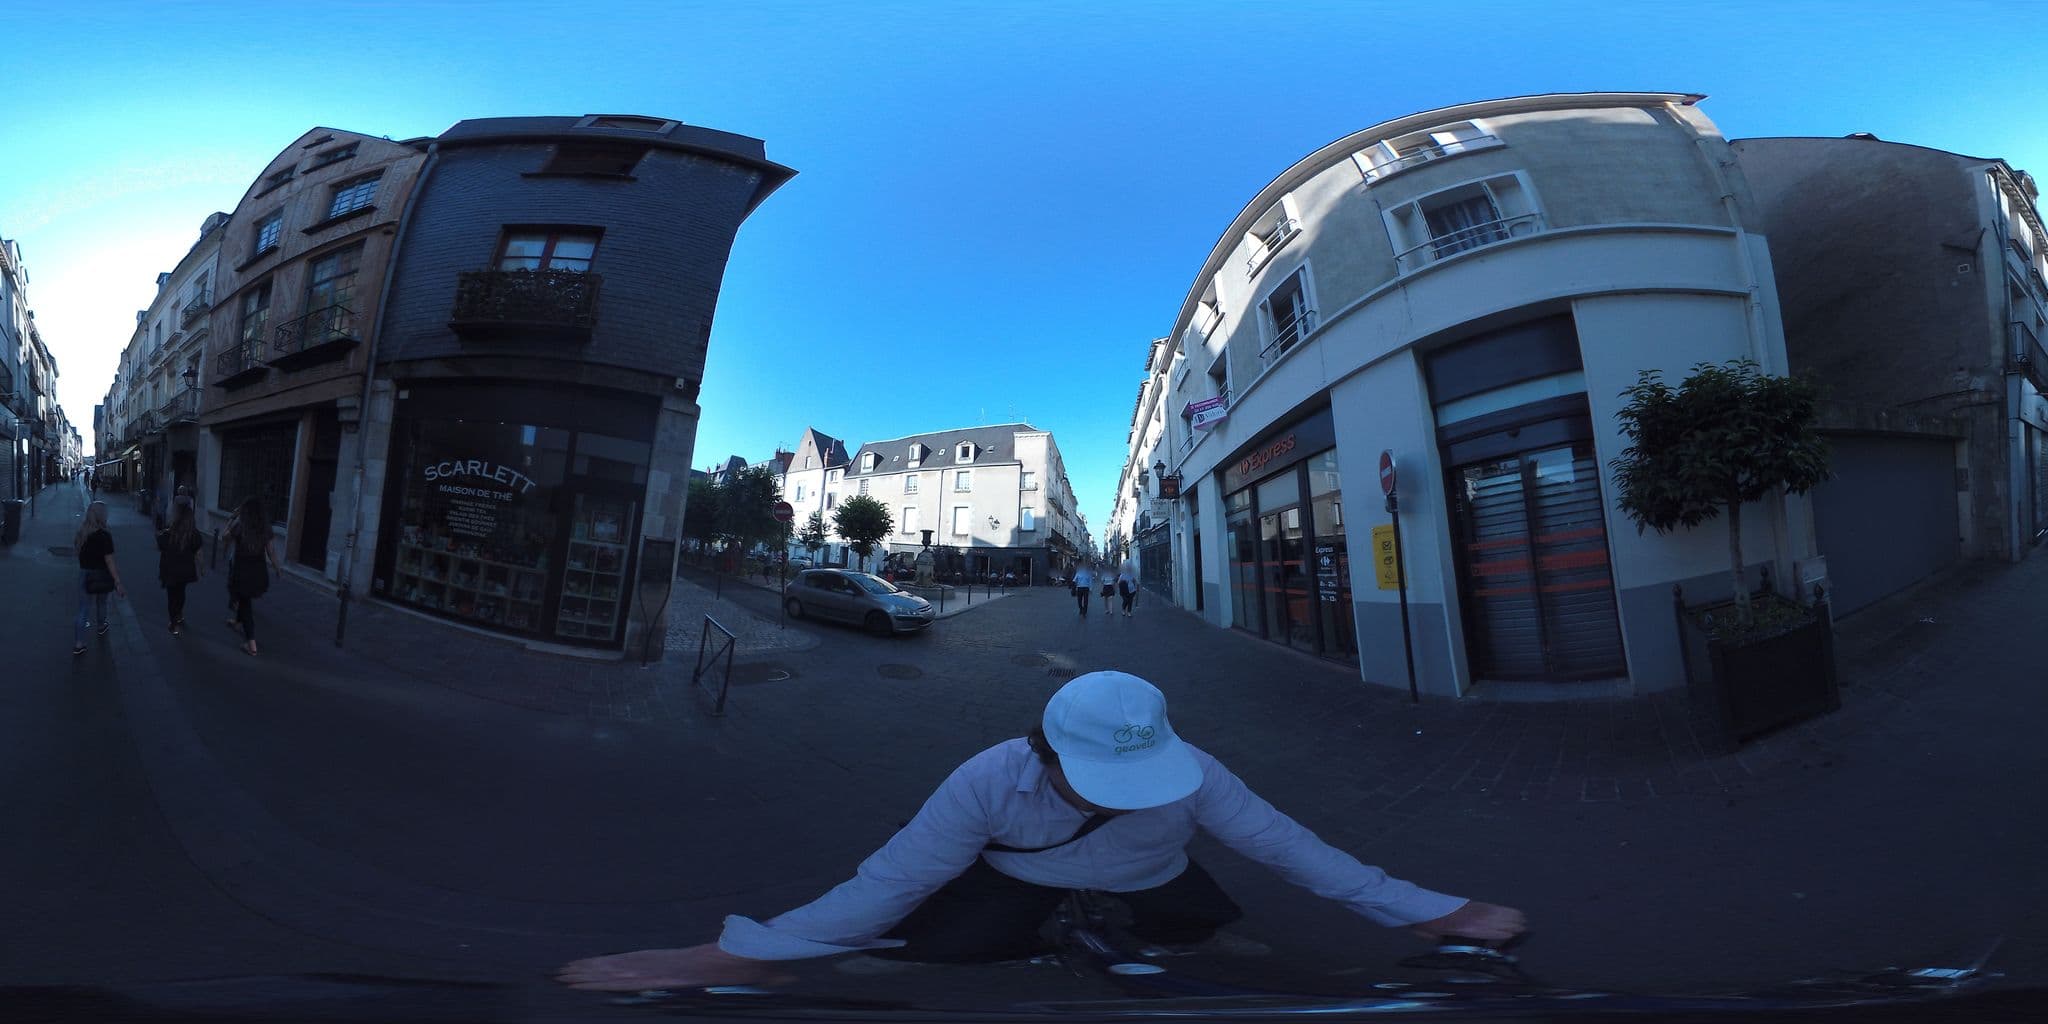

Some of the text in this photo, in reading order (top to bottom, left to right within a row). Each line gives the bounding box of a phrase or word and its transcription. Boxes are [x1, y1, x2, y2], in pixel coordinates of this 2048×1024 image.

[1250, 433, 1295, 466] Express
[424, 459, 536, 494] SCARLETT
[439, 484, 475, 496] MAISON
[477, 489, 491, 498] DE
